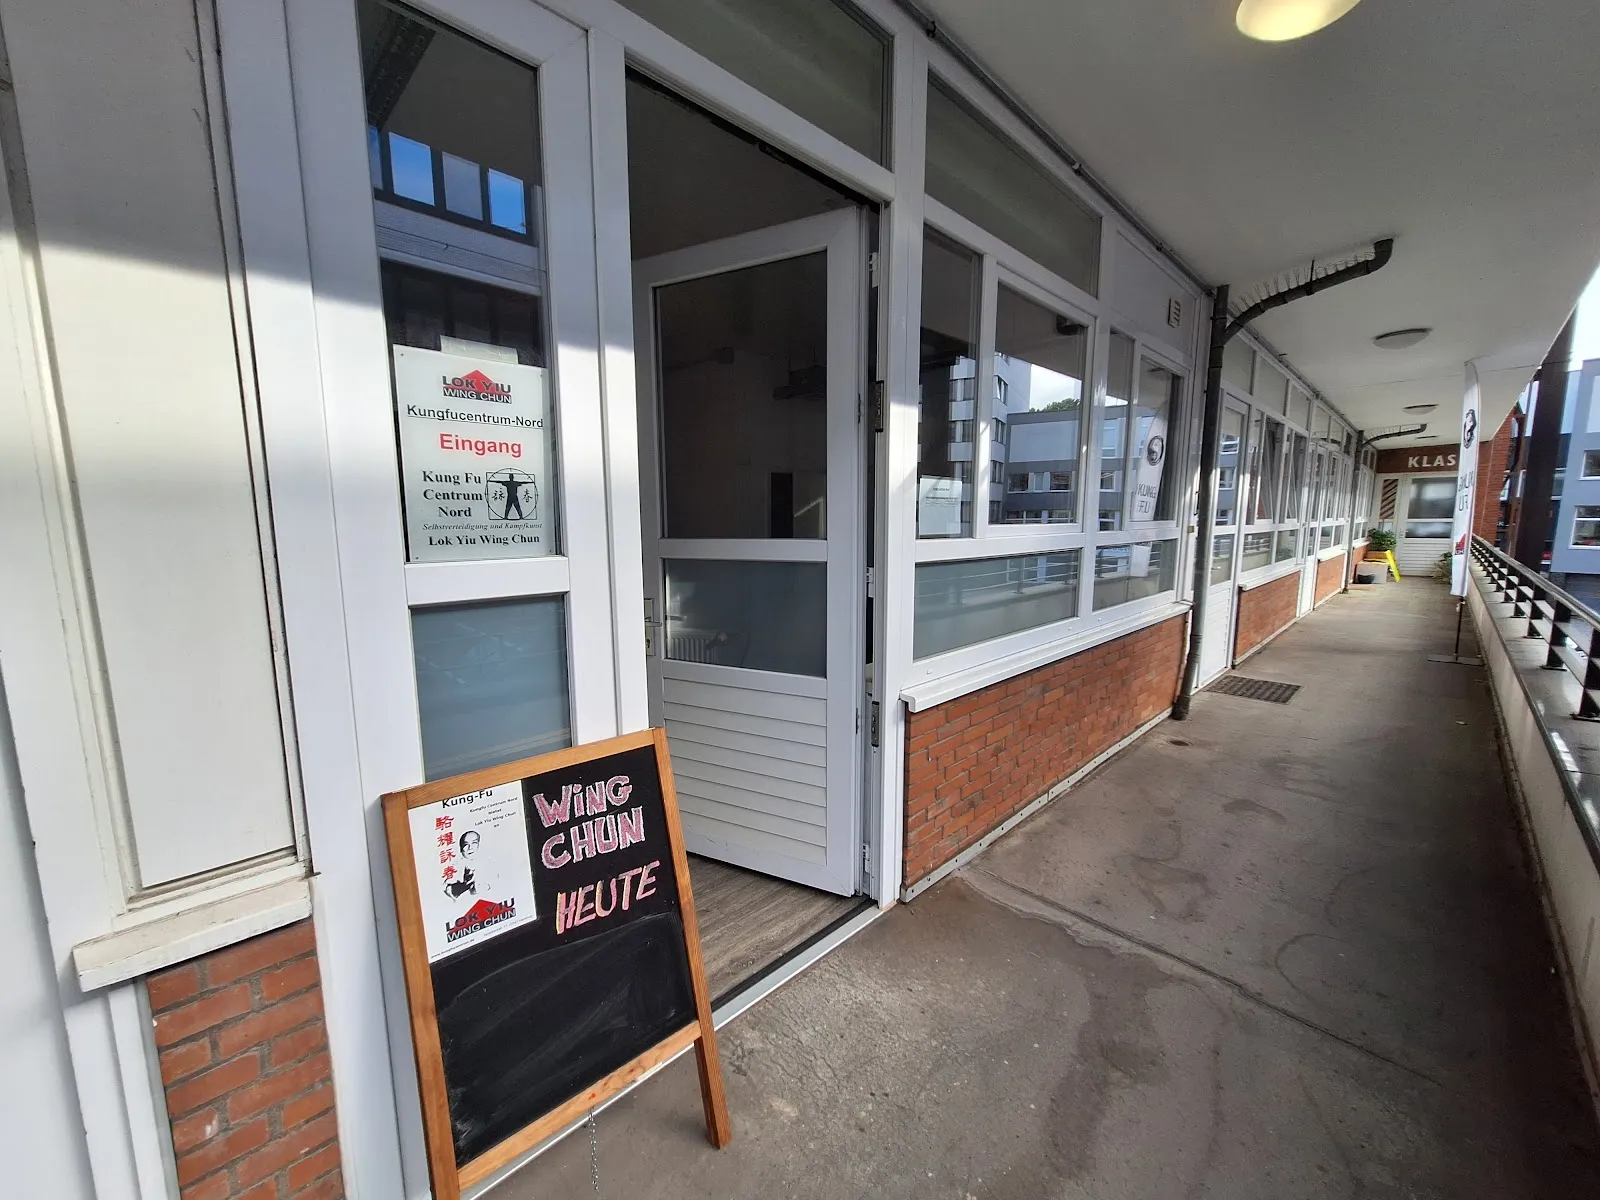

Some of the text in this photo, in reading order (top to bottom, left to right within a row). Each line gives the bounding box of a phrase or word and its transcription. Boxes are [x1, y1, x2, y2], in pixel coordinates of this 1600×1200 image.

[442, 375, 511, 393] LOK YIU
[443, 387, 512, 403] WING CHUN
[407, 404, 543, 428] Kungfucentrum-Nord
[439, 433, 522, 458] Eingang
[422, 470, 482, 485] Kung Fu
[423, 488, 483, 501] Centrum
[438, 506, 472, 517] Nord
[422, 523, 489, 531] Selbstverteidigung
[504, 522, 543, 531] Kampfkunst
[428, 533, 540, 546] Lok Yiu Wing Chun
[442, 789, 493, 809] Kung-Fu
[541, 805, 646, 869] CHUN
[555, 860, 661, 935] HEUTE
[445, 911, 480, 932] LOK
[485, 897, 515, 916] YIU
[448, 922, 480, 942] WING
[484, 908, 516, 927] CHUN
